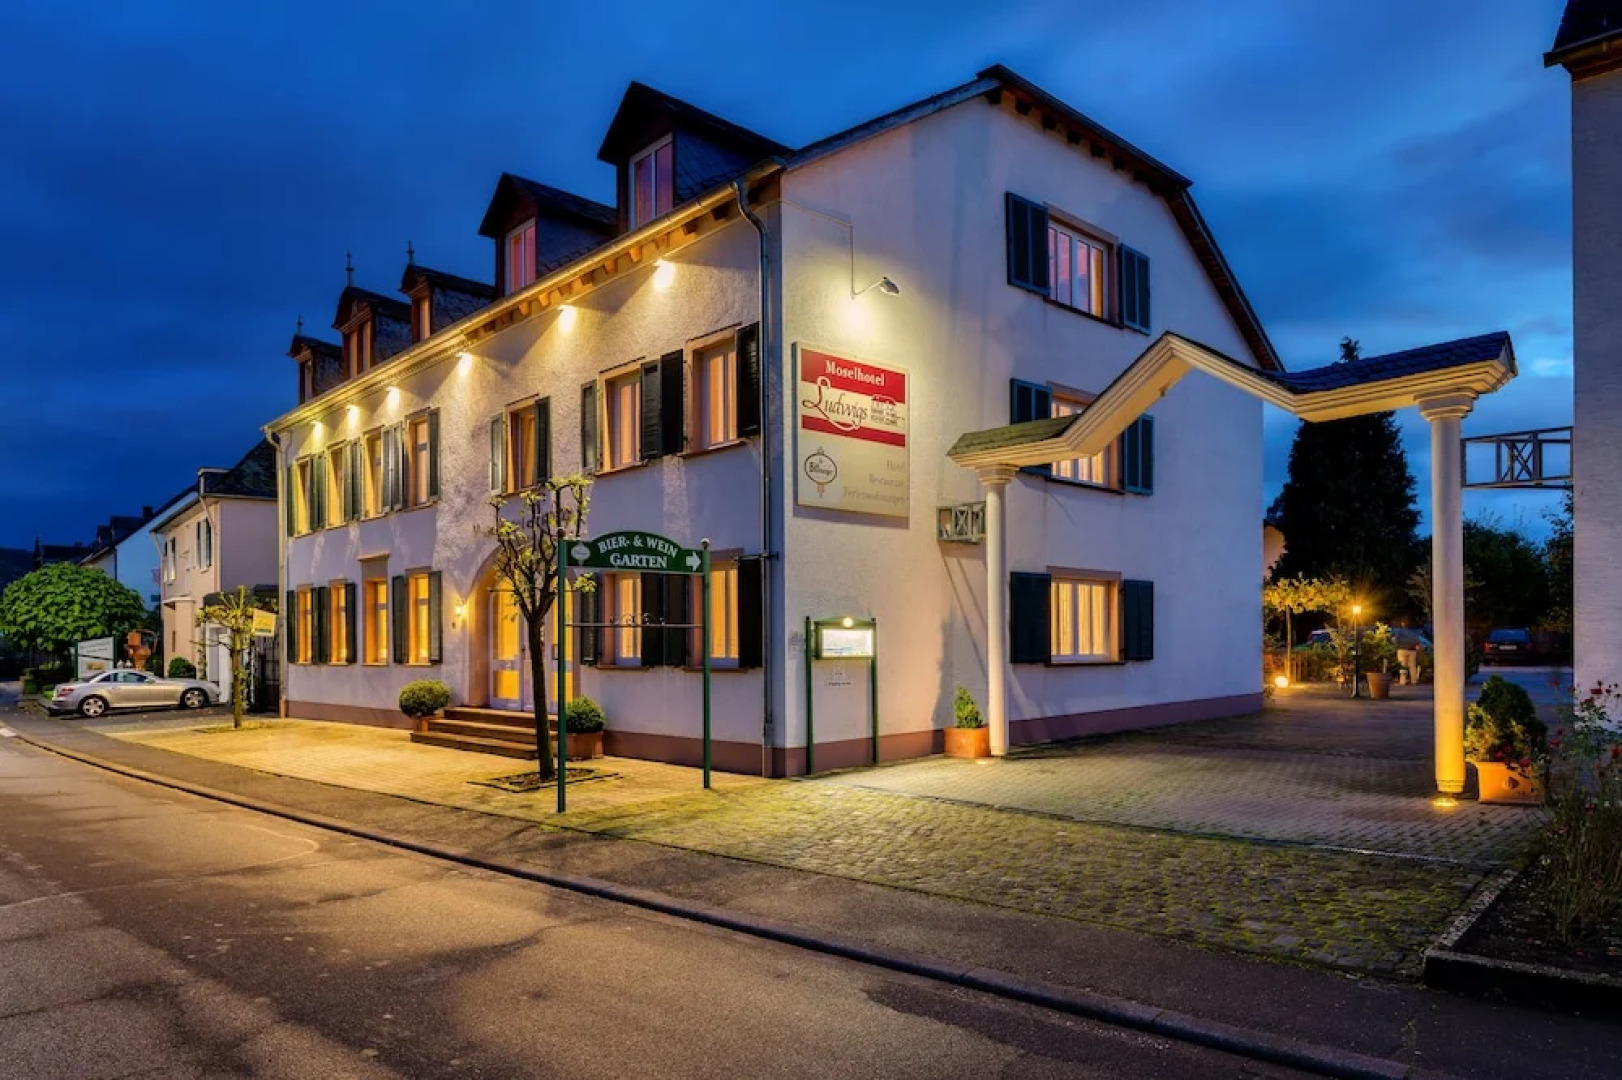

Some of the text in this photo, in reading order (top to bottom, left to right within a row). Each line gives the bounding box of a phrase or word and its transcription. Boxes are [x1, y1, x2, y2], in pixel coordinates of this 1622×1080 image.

[825, 359, 885, 387] Moselhotel
[802, 376, 868, 431] Ludwigs
[598, 536, 630, 553] BIER-
[633, 535, 643, 547] &
[647, 537, 679, 558] WEIN
[610, 553, 668, 568] GARTEN
